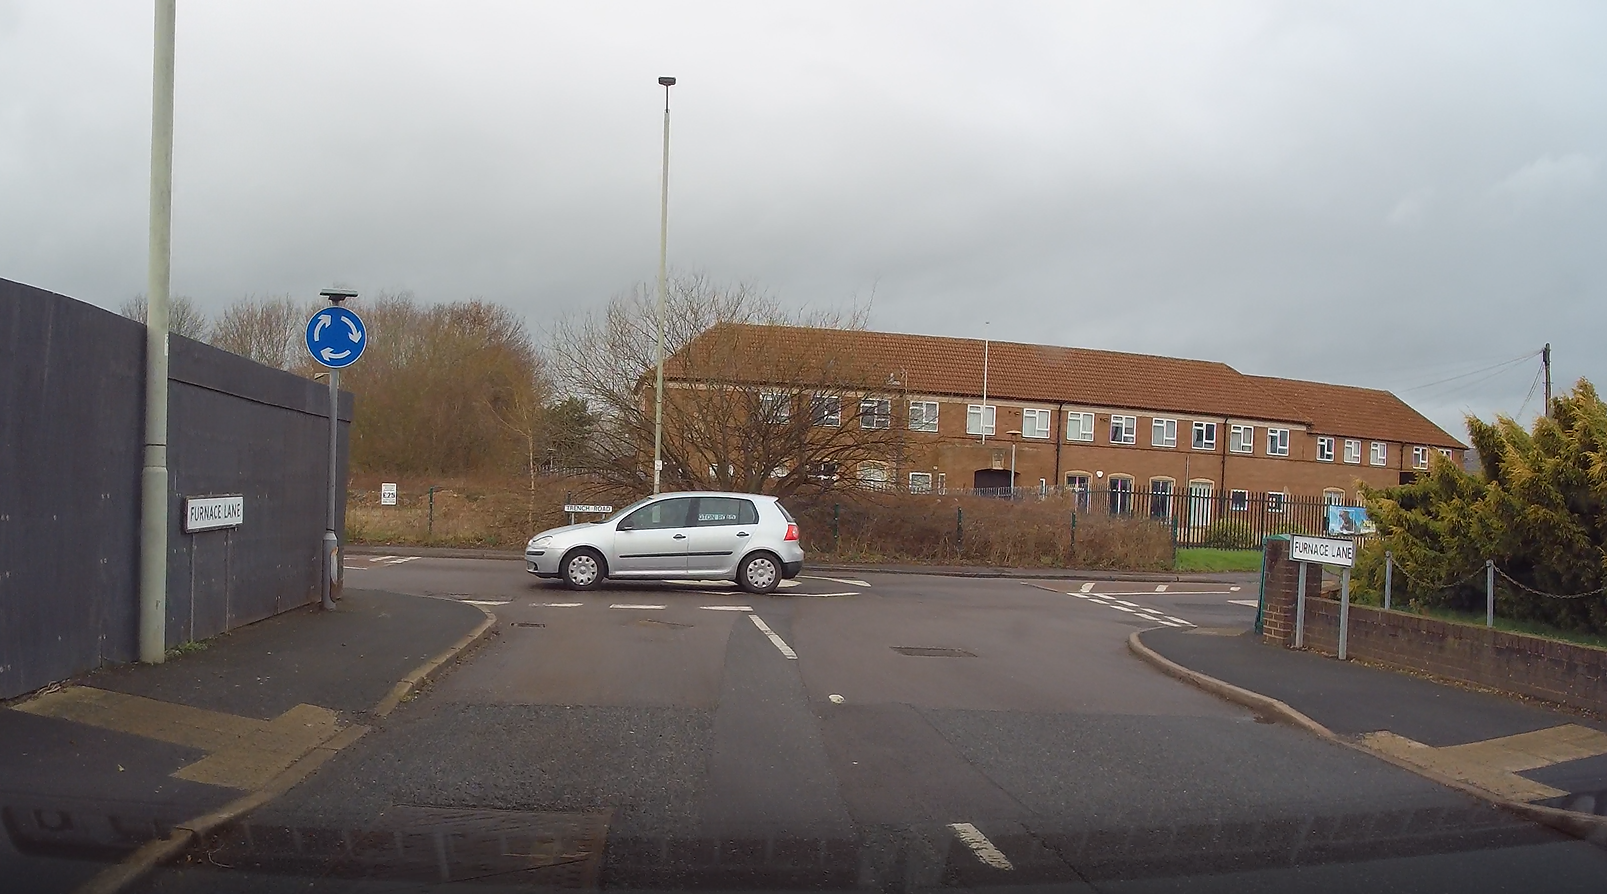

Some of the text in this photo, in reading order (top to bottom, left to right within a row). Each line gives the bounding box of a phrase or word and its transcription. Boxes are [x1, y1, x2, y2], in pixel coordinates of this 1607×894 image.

[190, 503, 241, 522] FURNACE LANE
[1294, 541, 1352, 560] FURNACE LANE
